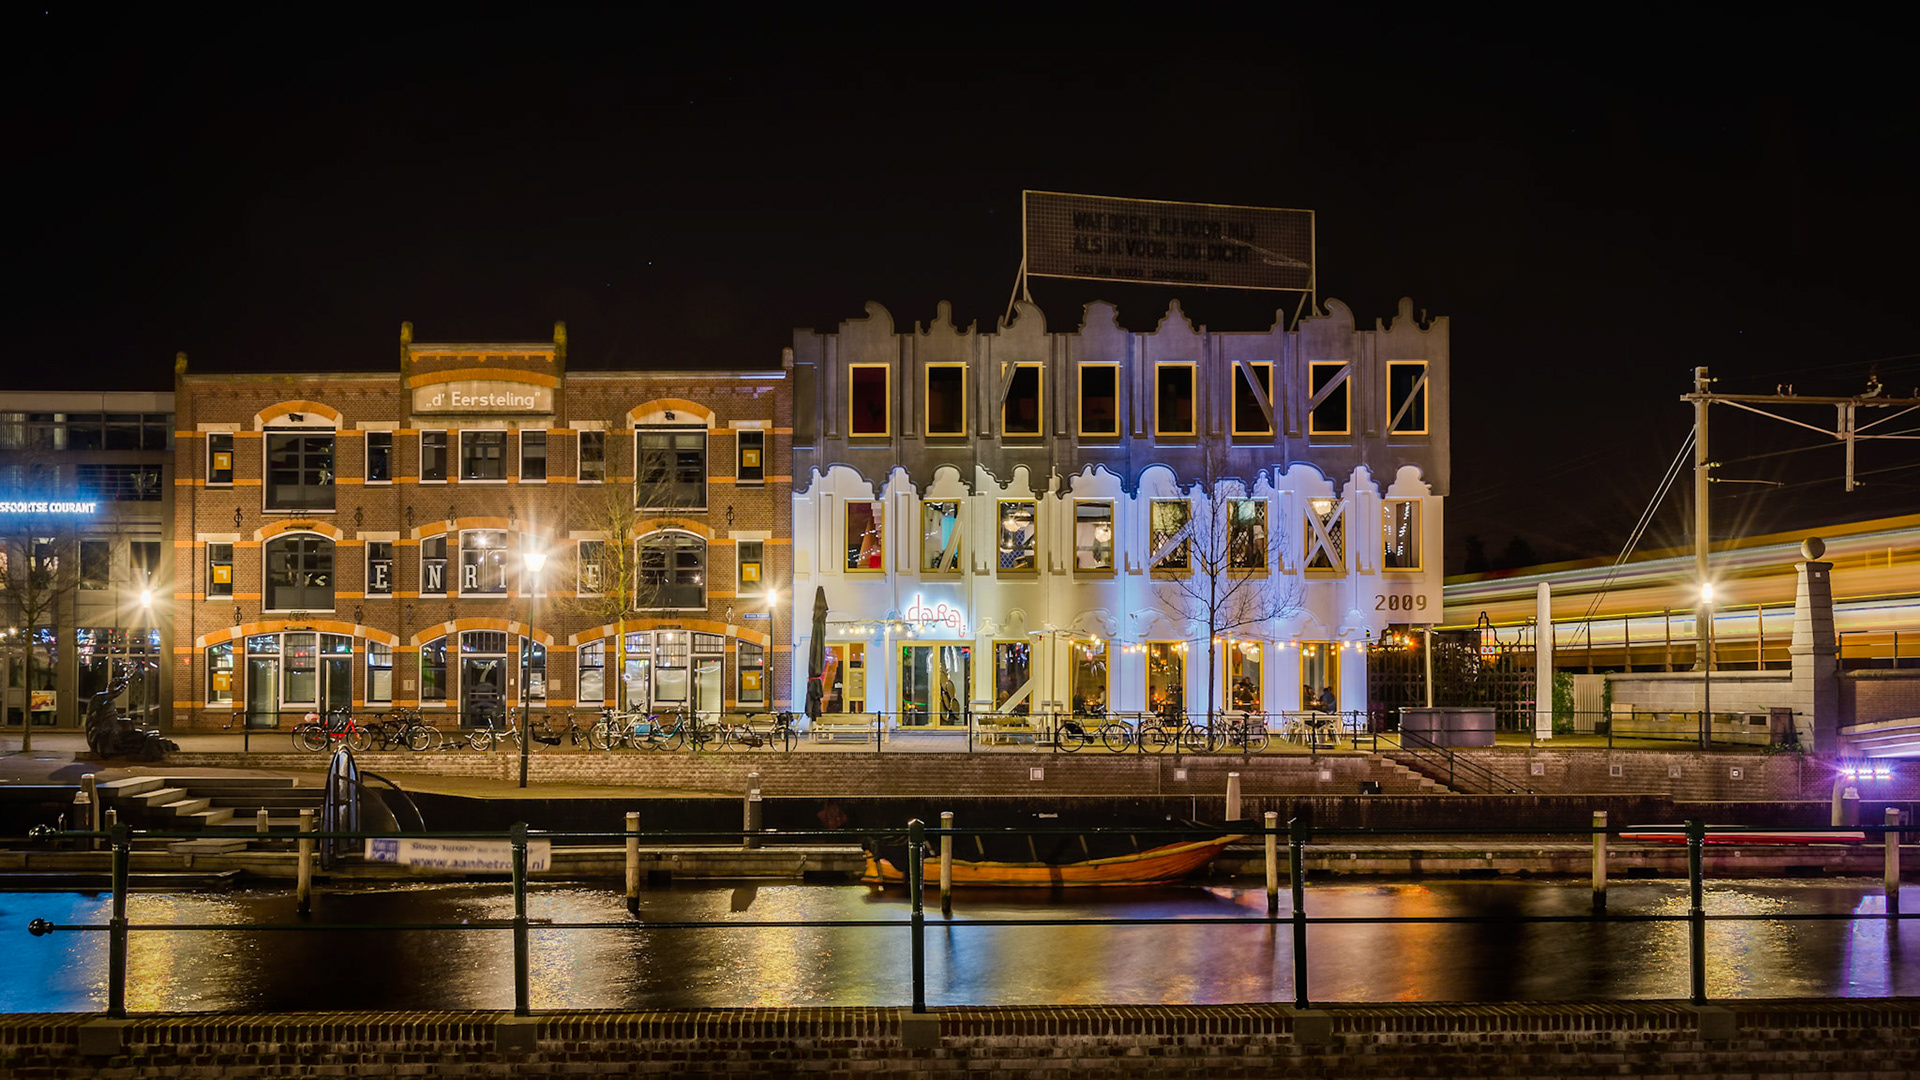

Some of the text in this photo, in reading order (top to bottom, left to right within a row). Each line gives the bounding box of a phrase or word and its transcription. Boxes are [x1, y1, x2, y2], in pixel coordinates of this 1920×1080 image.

[1109, 213, 1149, 234] OPEN
[1073, 235, 1102, 254] ALS
[1126, 239, 1167, 259] VOOR
[1207, 243, 1249, 264] DICHT
[48, 502, 96, 514] COURANT
[1375, 594, 1427, 611] 2009
